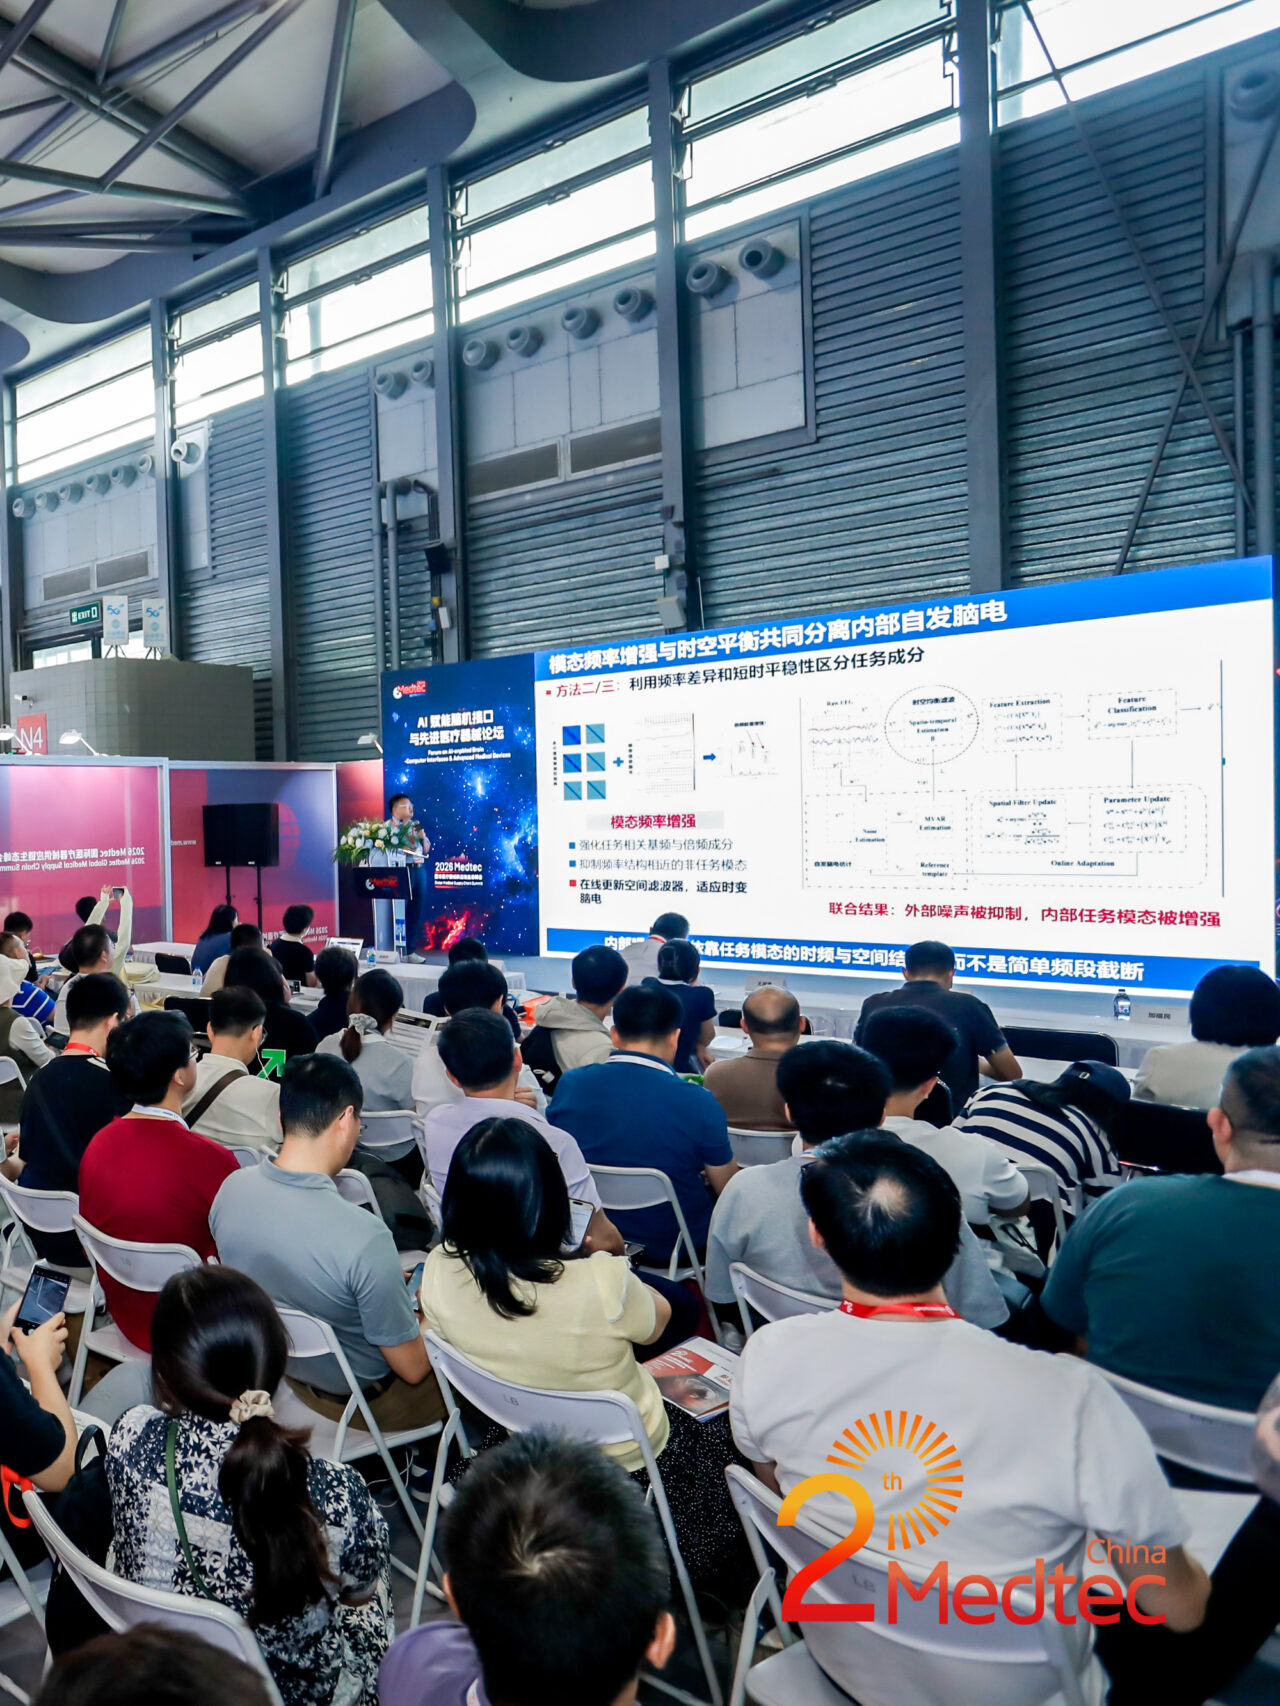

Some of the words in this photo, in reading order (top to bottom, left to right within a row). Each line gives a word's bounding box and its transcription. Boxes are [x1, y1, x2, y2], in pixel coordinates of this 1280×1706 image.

[77, 610, 91, 620] EXIT
[549, 599, 1007, 675] 模态频率增强与时空平衡共同分离内部自发脑电
[989, 701, 1014, 709] Feature
[1015, 698, 1051, 707] Extraction
[1118, 696, 1146, 704] Feature
[1107, 705, 1157, 714] Classification
[417, 716, 428, 729] AI
[430, 709, 494, 728] 赋能脑机接口
[20, 727, 43, 750] N4
[409, 725, 505, 746] 与先进医疗器械论坛
[1032, 799, 1057, 807] Update
[1103, 796, 1141, 804] Parameter
[1144, 795, 1171, 804] Update
[611, 813, 696, 829] 模态频率增强
[579, 838, 734, 851] 强化任务相关基频与倍频成分
[435, 862, 453, 871] 2026
[454, 862, 483, 872] Medtec
[580, 859, 748, 871] 抑制频率结构相近的非任务模态
[1051, 859, 1074, 867] Online
[1076, 860, 1116, 868] Adaptation
[580, 893, 602, 905] 脑电
